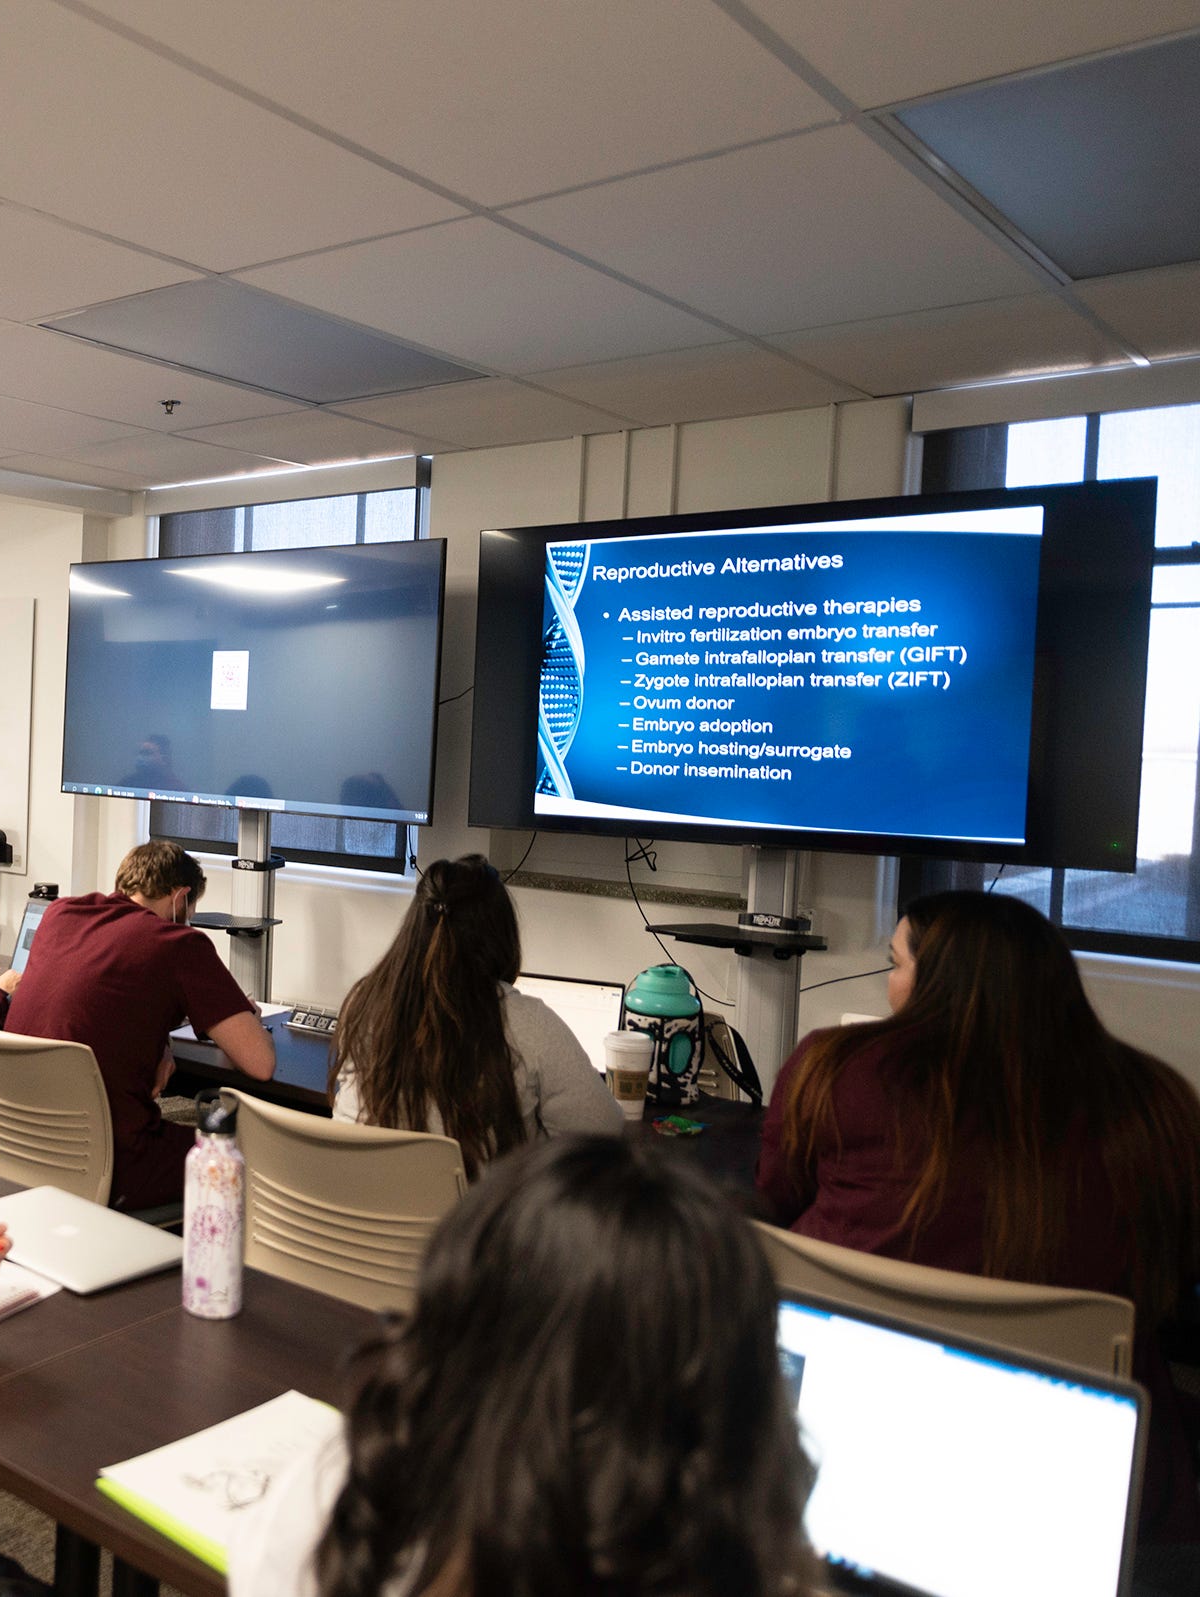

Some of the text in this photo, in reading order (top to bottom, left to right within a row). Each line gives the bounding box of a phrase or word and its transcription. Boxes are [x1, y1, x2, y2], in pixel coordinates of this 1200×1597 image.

[593, 554, 843, 583] Reproductive Alternatives
[618, 597, 921, 622] Assisted reproductive therapies
[637, 622, 938, 643] Invitro fertilization embryo transfer
[636, 646, 967, 667] Gamete intrafallopian transfer (GIFT)
[634, 671, 950, 690] Zygote intrafallopian transfer (ZIFT)
[634, 696, 735, 709] Ovum donor
[633, 718, 772, 735] Embryo adoption
[632, 740, 851, 761] Embryo hosting/surrogate
[631, 761, 791, 780] Donor insemination
